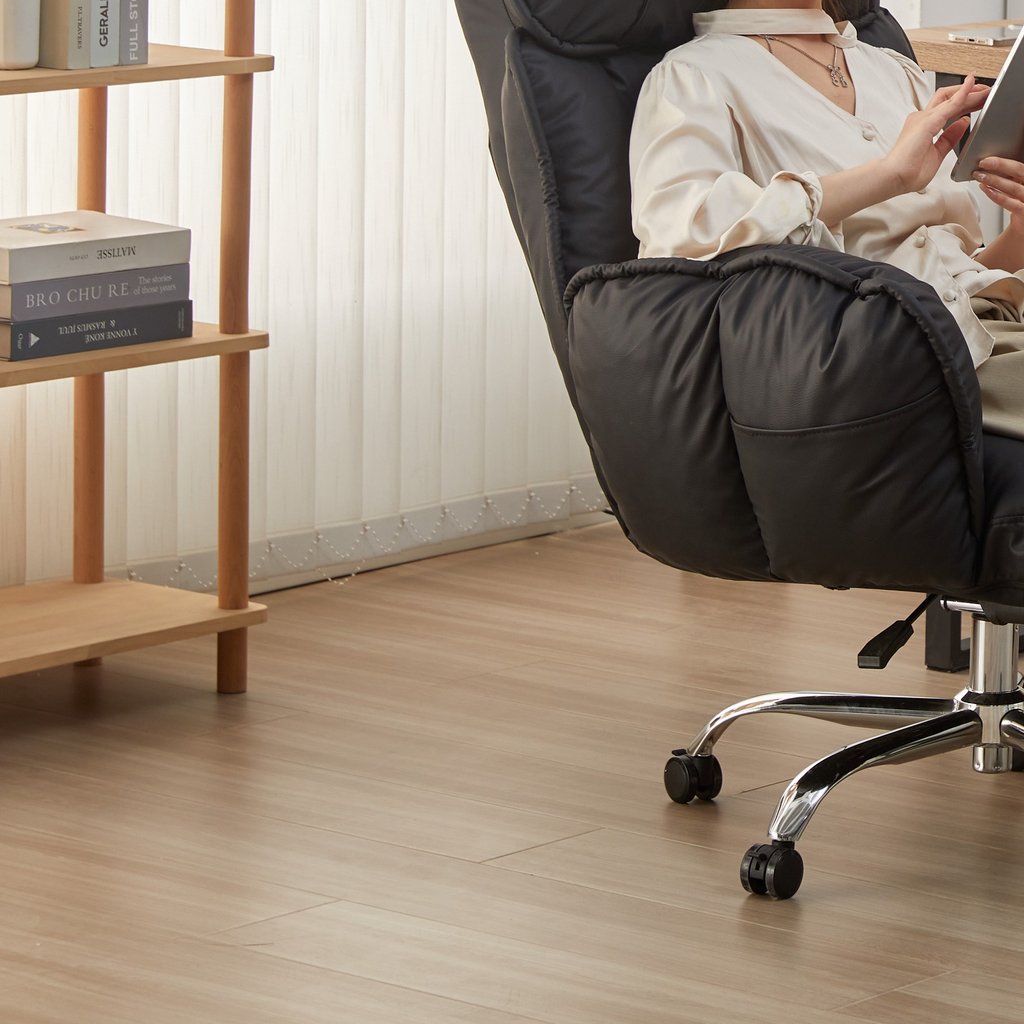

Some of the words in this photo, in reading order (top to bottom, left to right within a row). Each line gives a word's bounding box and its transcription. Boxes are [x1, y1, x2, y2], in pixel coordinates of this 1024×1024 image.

[129, 24, 139, 61] FULL
[96, 245, 137, 260] MATISSE
[138, 276, 151, 285] The
[152, 274, 172, 283] stories
[133, 286, 141, 295] of
[141, 285, 159, 295] those
[159, 283, 176, 293] years
[76, 320, 106, 333] RASMUS
[110, 319, 116, 327] &
